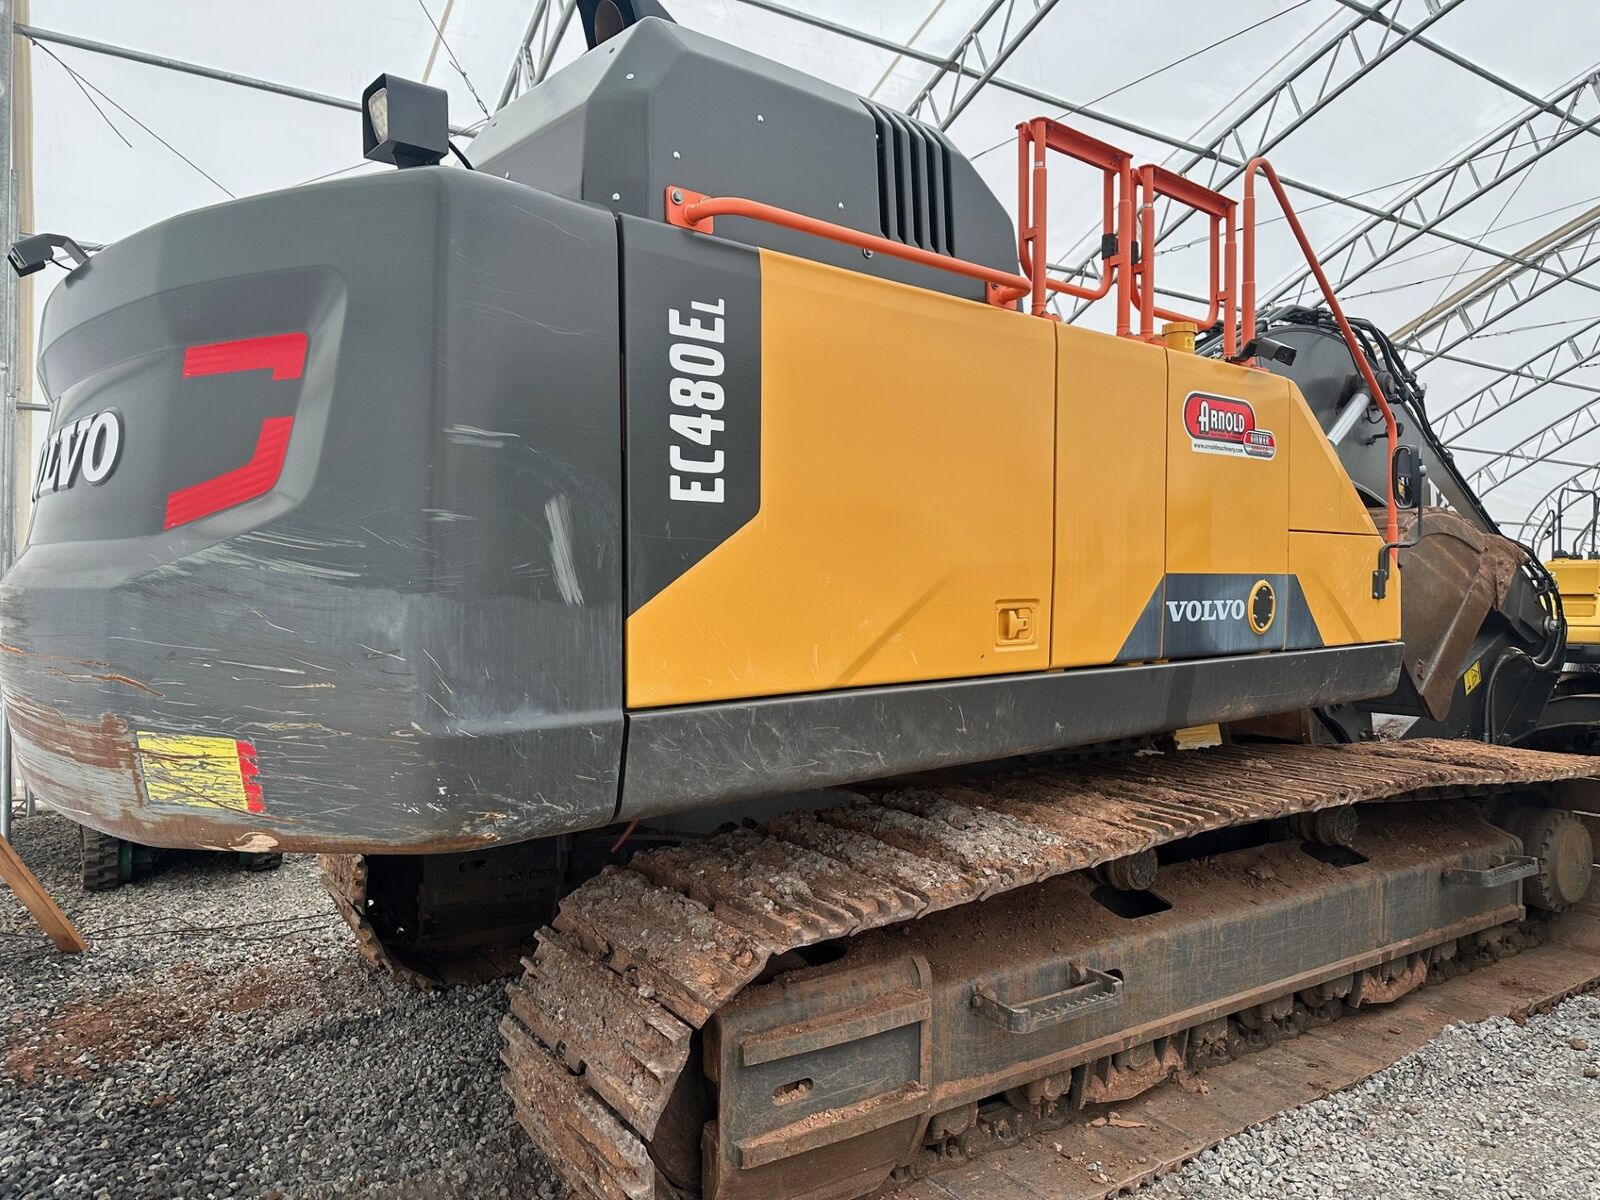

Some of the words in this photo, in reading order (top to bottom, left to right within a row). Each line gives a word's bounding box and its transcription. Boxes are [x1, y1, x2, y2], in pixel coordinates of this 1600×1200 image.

[669, 298, 725, 503] EC480EL
[1198, 400, 1245, 433] ARNOLD
[32, 409, 122, 502] OLVO
[1165, 599, 1246, 622] VOLVO
